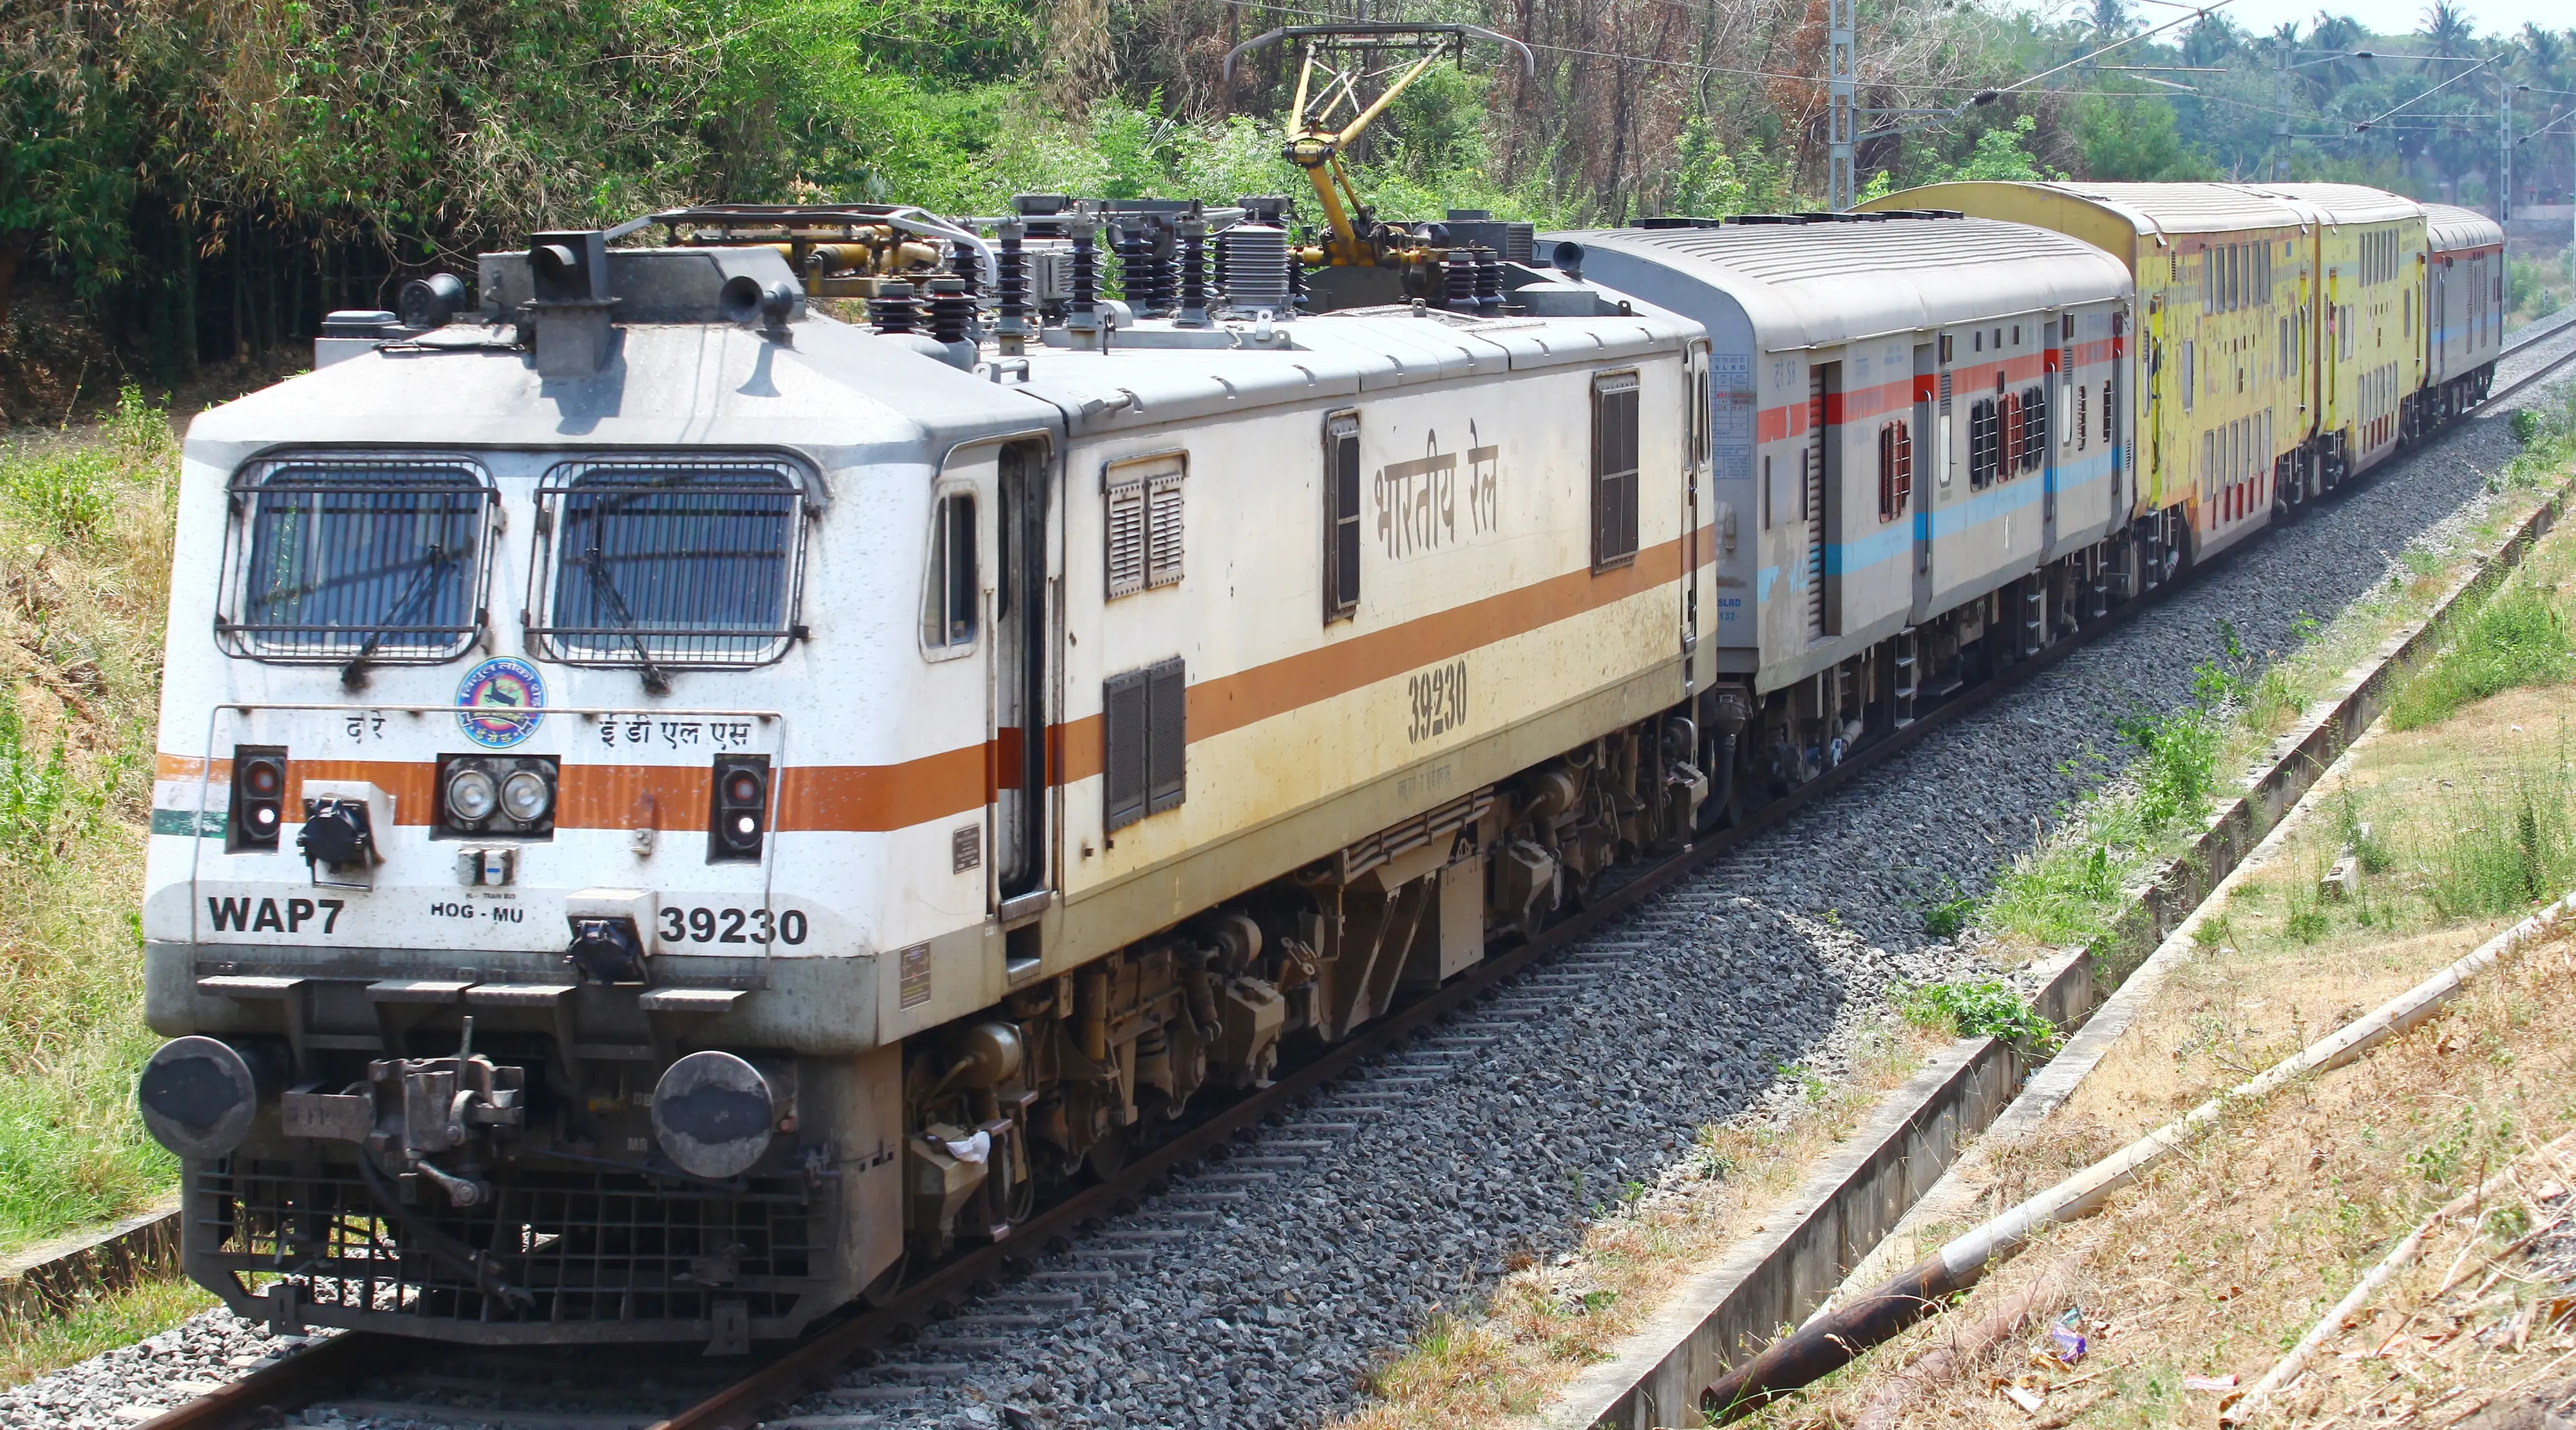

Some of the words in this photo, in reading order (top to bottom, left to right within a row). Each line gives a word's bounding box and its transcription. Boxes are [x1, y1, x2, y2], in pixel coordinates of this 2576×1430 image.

[1375, 428, 1457, 560] भारतीय
[1468, 417, 1498, 536] रेल
[1408, 660, 1467, 745] 39230
[208, 897, 344, 934] WAP7
[431, 902, 474, 919] HOG
[494, 907, 523, 923] MU
[659, 907, 807, 945] 39230
